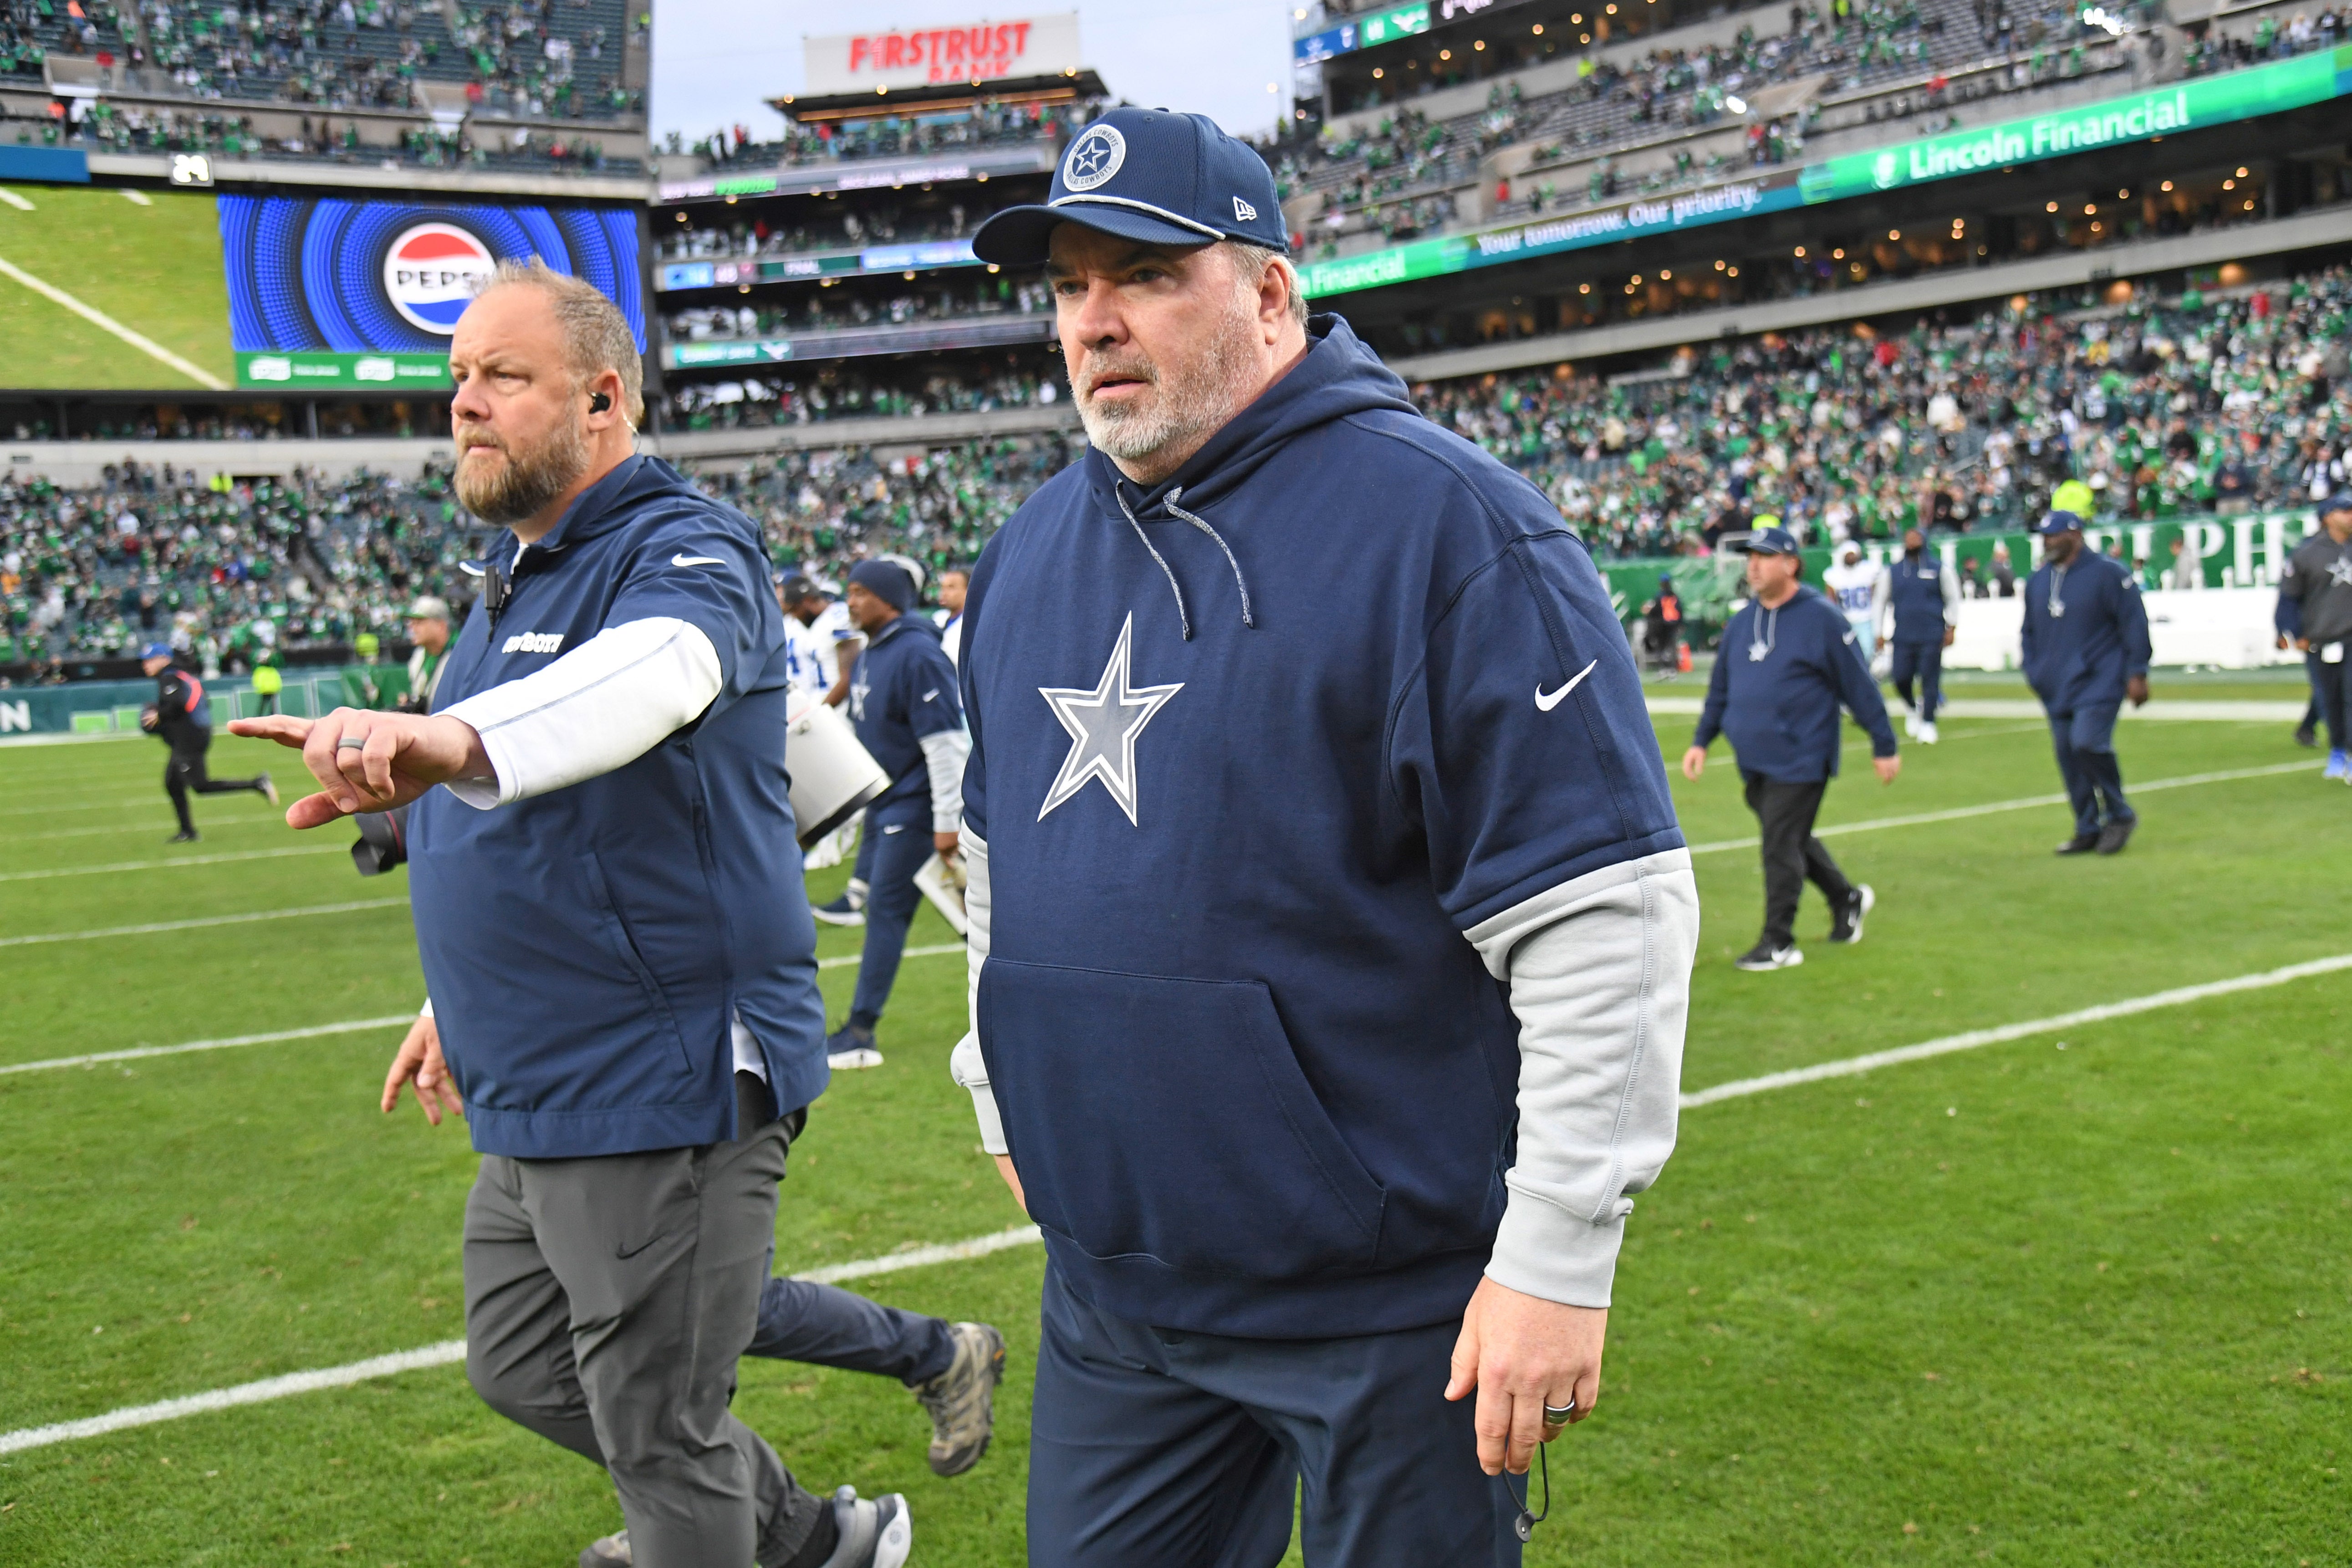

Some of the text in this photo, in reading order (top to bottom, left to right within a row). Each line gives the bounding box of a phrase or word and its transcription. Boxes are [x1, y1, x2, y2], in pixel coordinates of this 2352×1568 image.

[1093, 129, 1118, 147] COWBOYS
[1910, 91, 2190, 179] Lincoln Financial
[1081, 165, 1112, 184] COWBOYS
